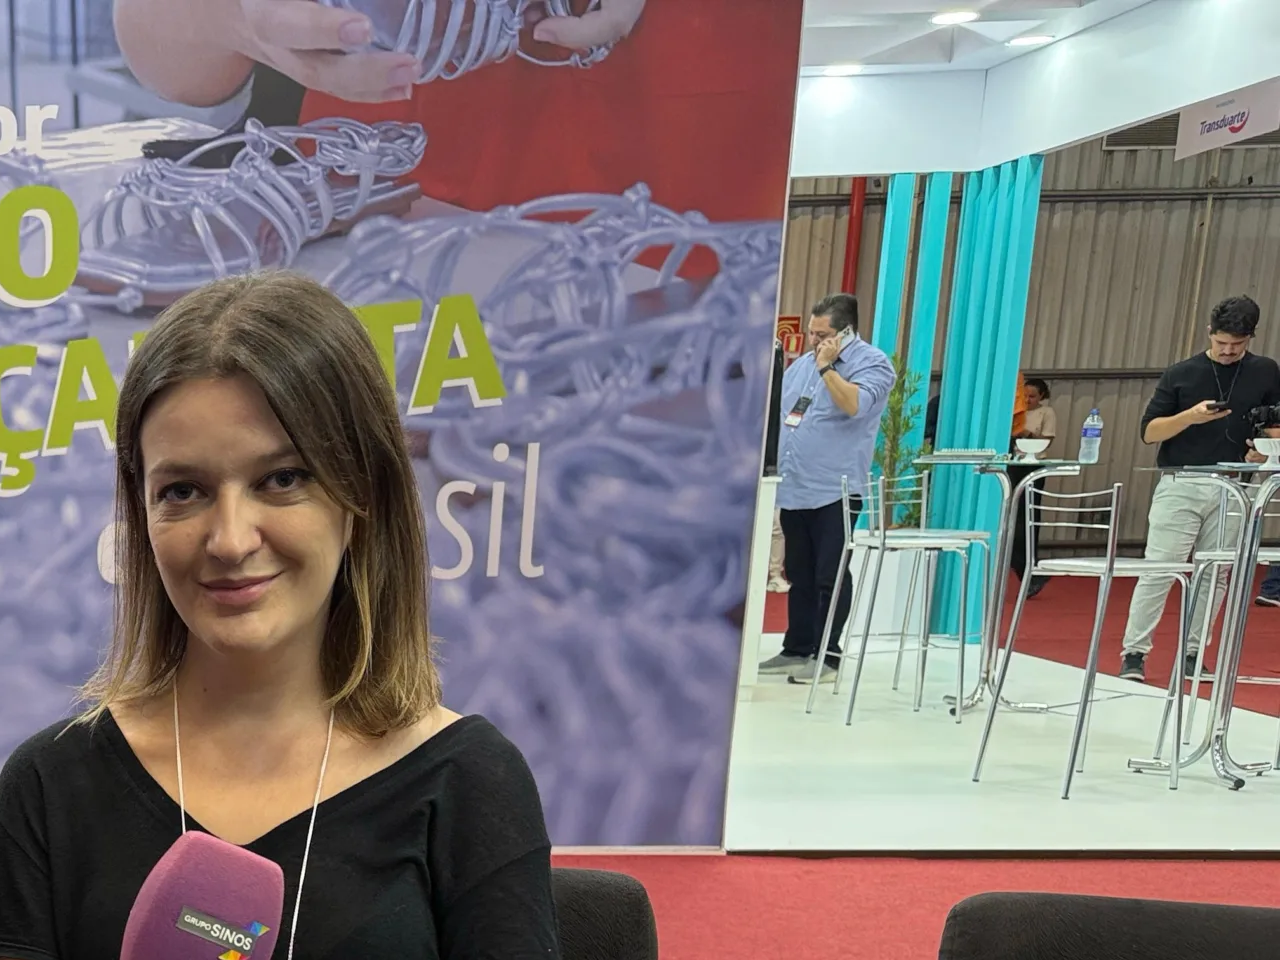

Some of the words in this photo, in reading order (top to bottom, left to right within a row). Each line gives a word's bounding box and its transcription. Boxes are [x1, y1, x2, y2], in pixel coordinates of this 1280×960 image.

[1200, 110, 1246, 136] Transduarte
[184, 914, 211, 931] GRUPO
[210, 923, 253, 951] SINOS
